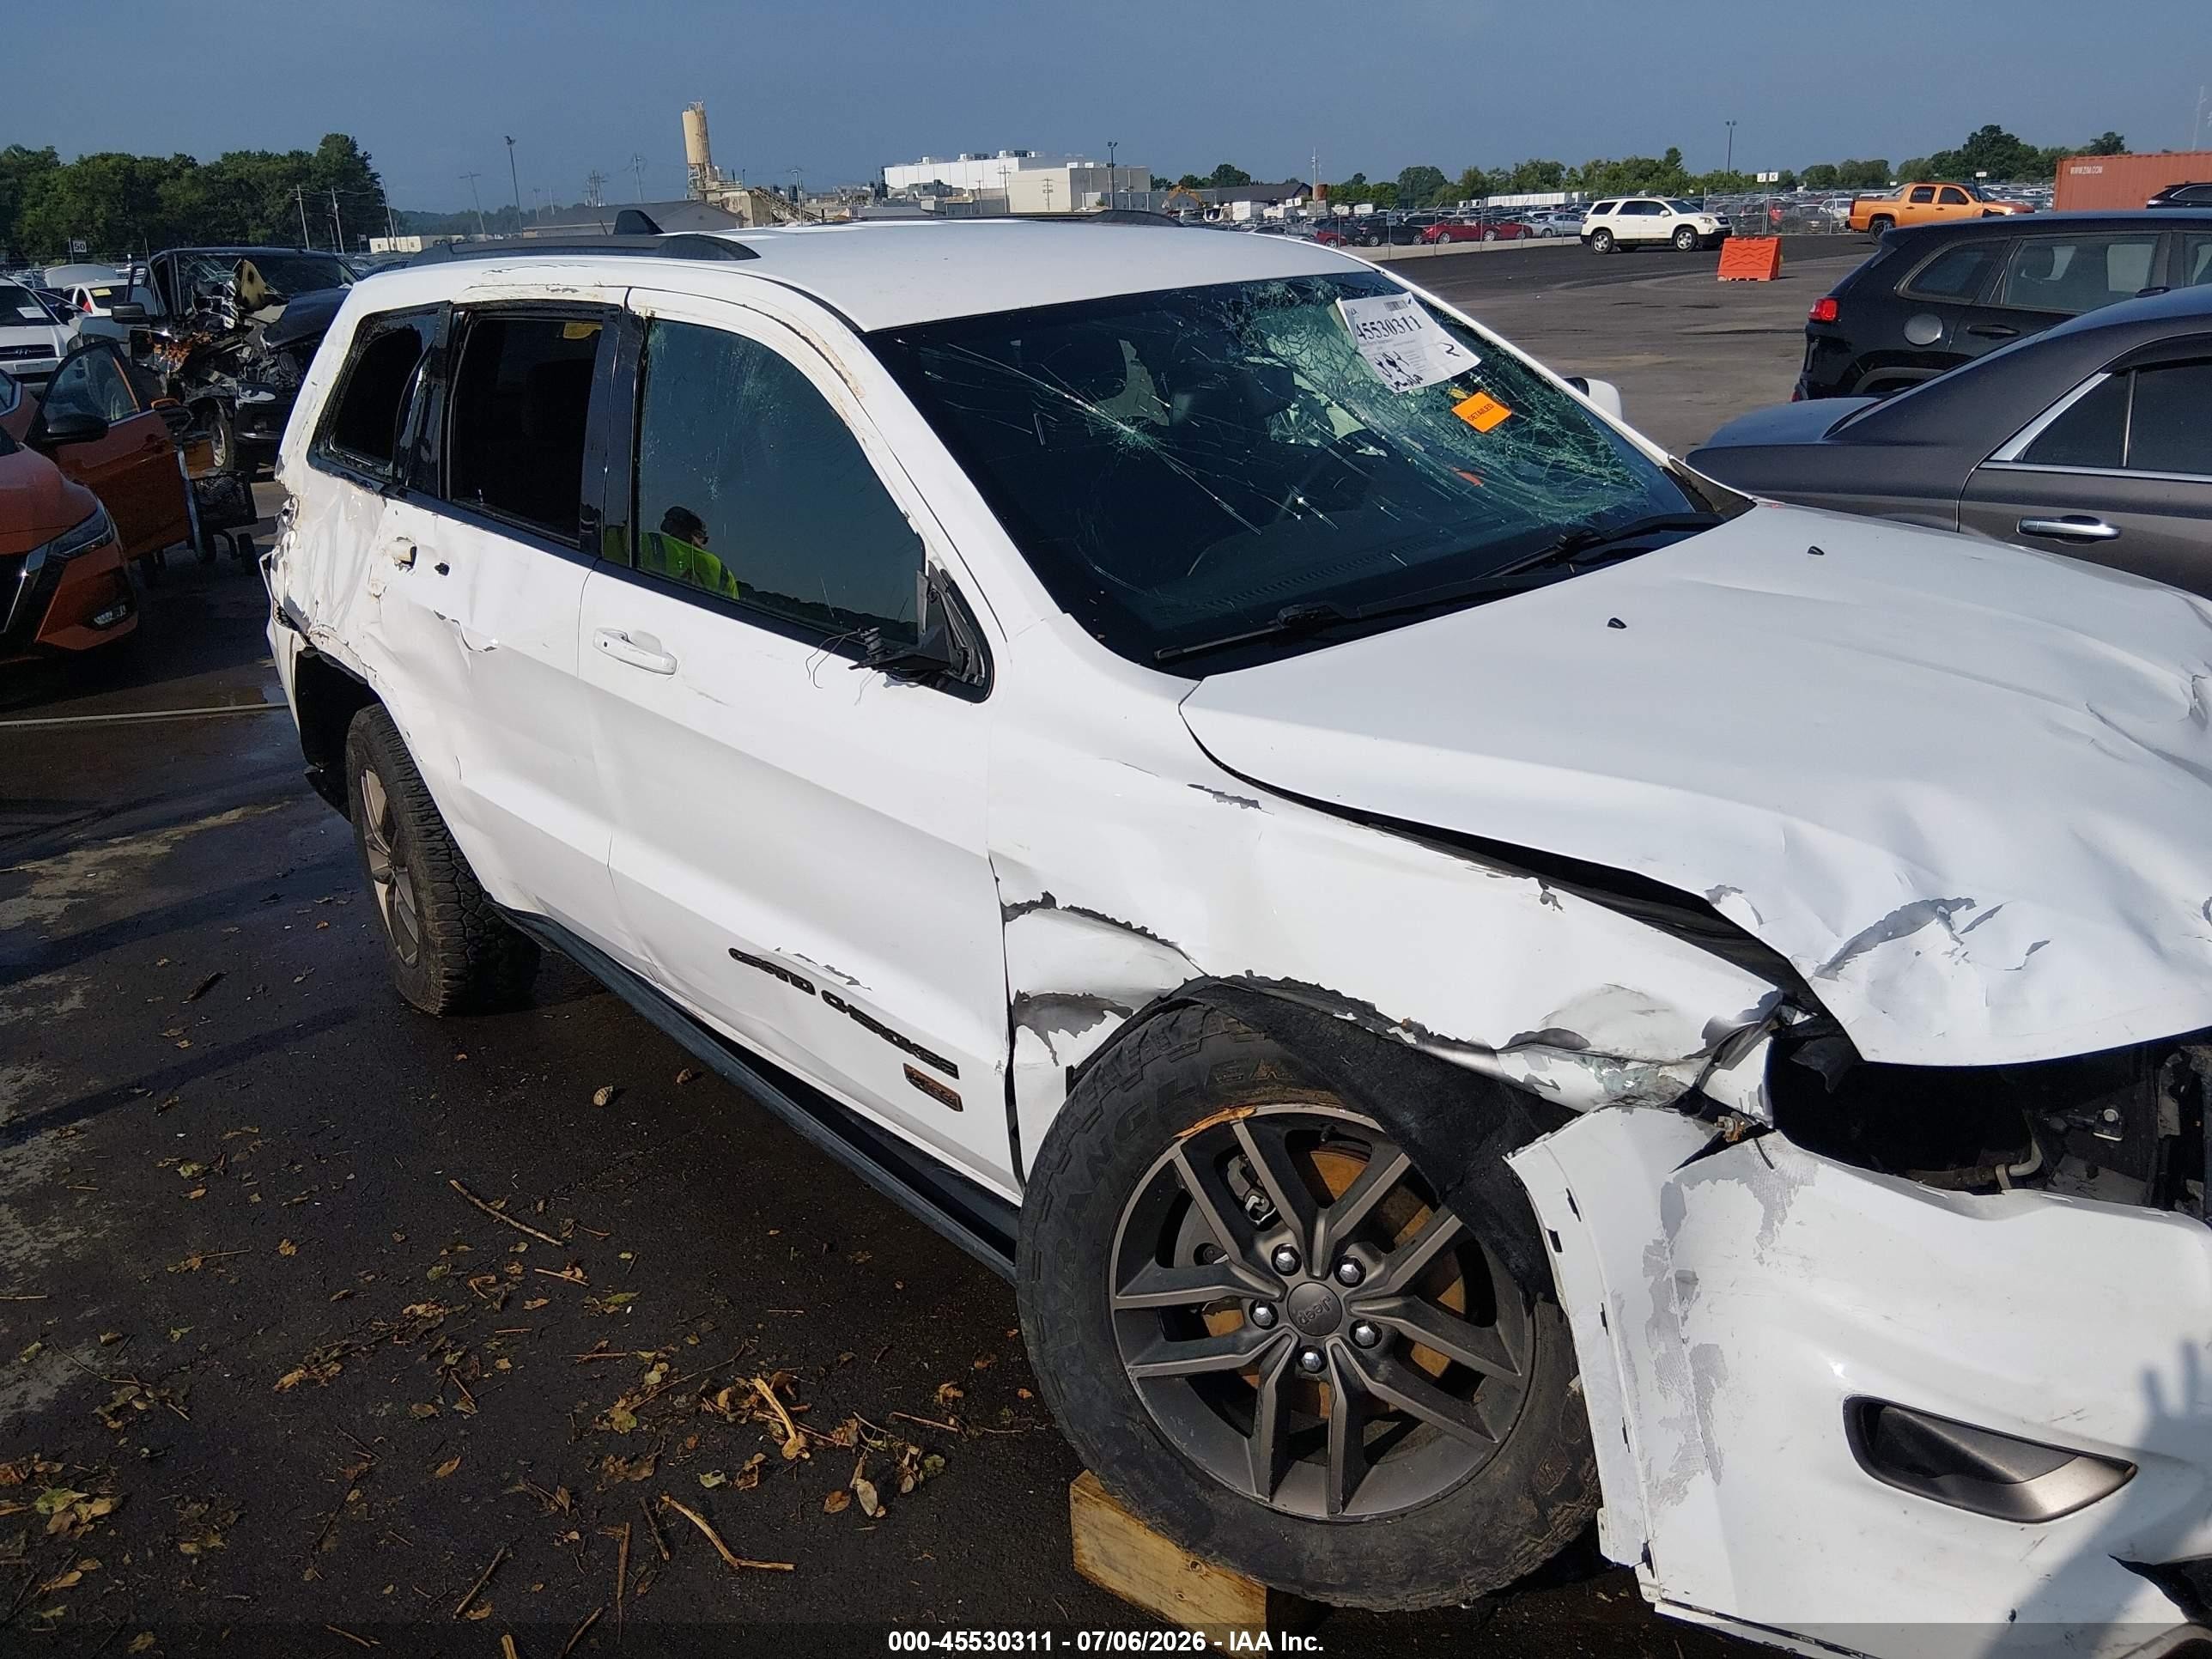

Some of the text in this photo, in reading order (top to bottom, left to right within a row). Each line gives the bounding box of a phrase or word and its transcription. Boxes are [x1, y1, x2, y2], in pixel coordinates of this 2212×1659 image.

[74, 242, 86, 251] 50
[1356, 315, 1422, 341] 45530311
[1467, 403, 1495, 422] DETAILED
